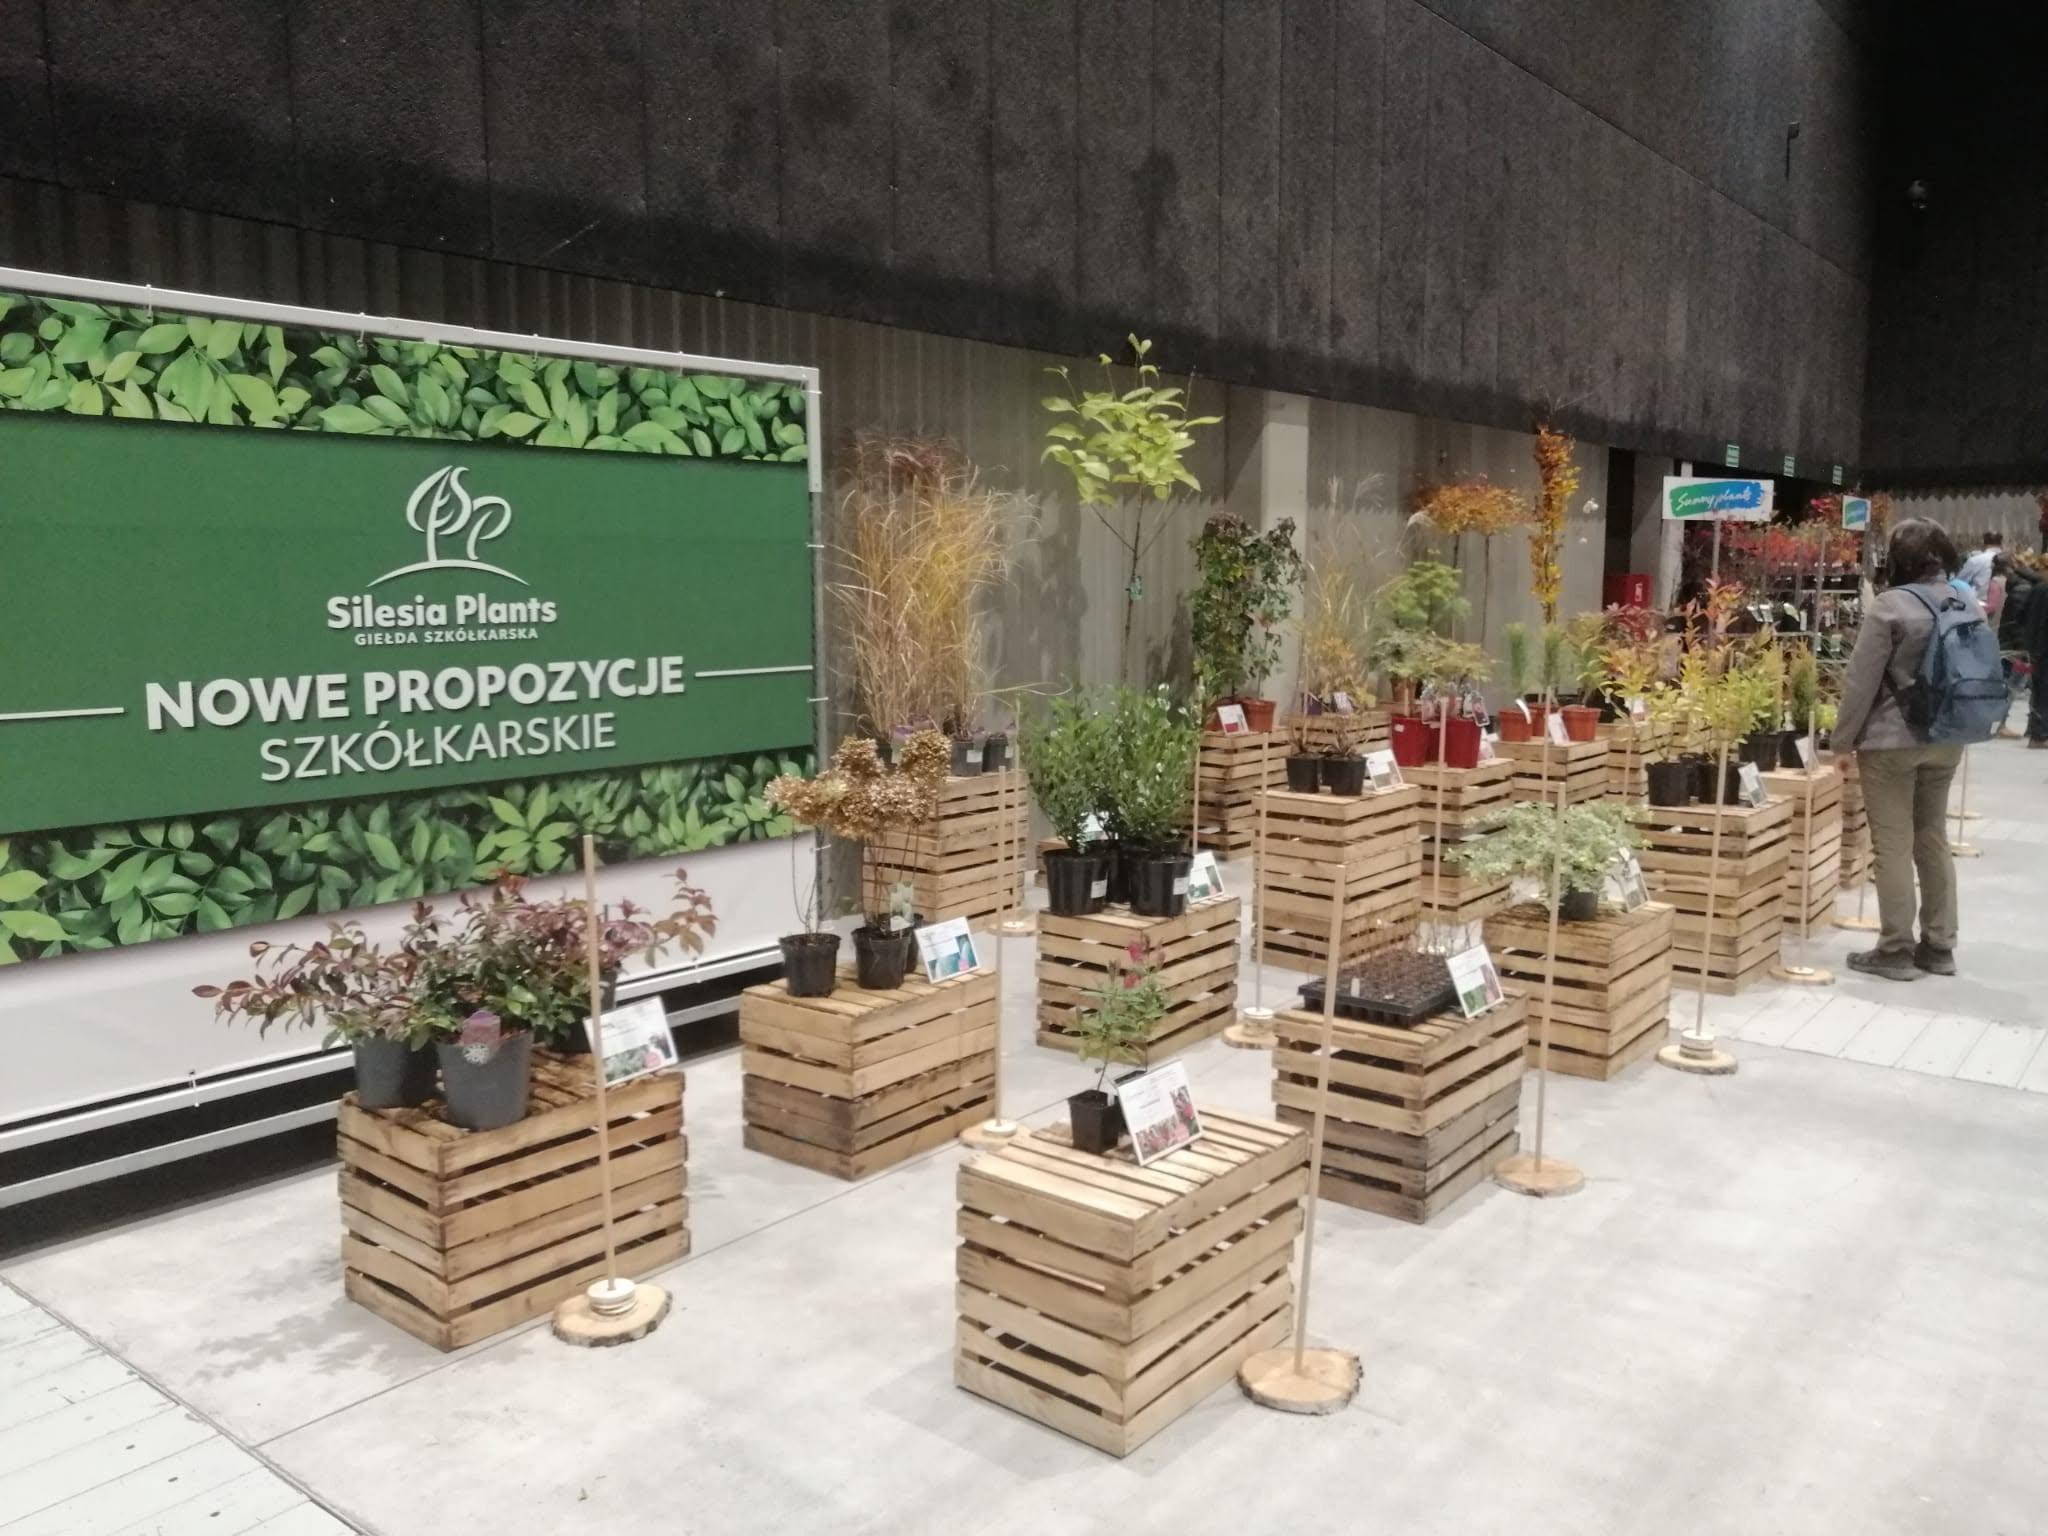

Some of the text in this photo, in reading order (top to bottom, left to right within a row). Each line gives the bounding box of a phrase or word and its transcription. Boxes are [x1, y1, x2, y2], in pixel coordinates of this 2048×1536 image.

[327, 593, 557, 628] Silesia Plants
[354, 627, 538, 646] GIEŁDA SZKÓŁKARSKA
[146, 656, 685, 730] NOWE PROPOZYCJE
[260, 712, 616, 782] SZKÓŁKARSKIE
